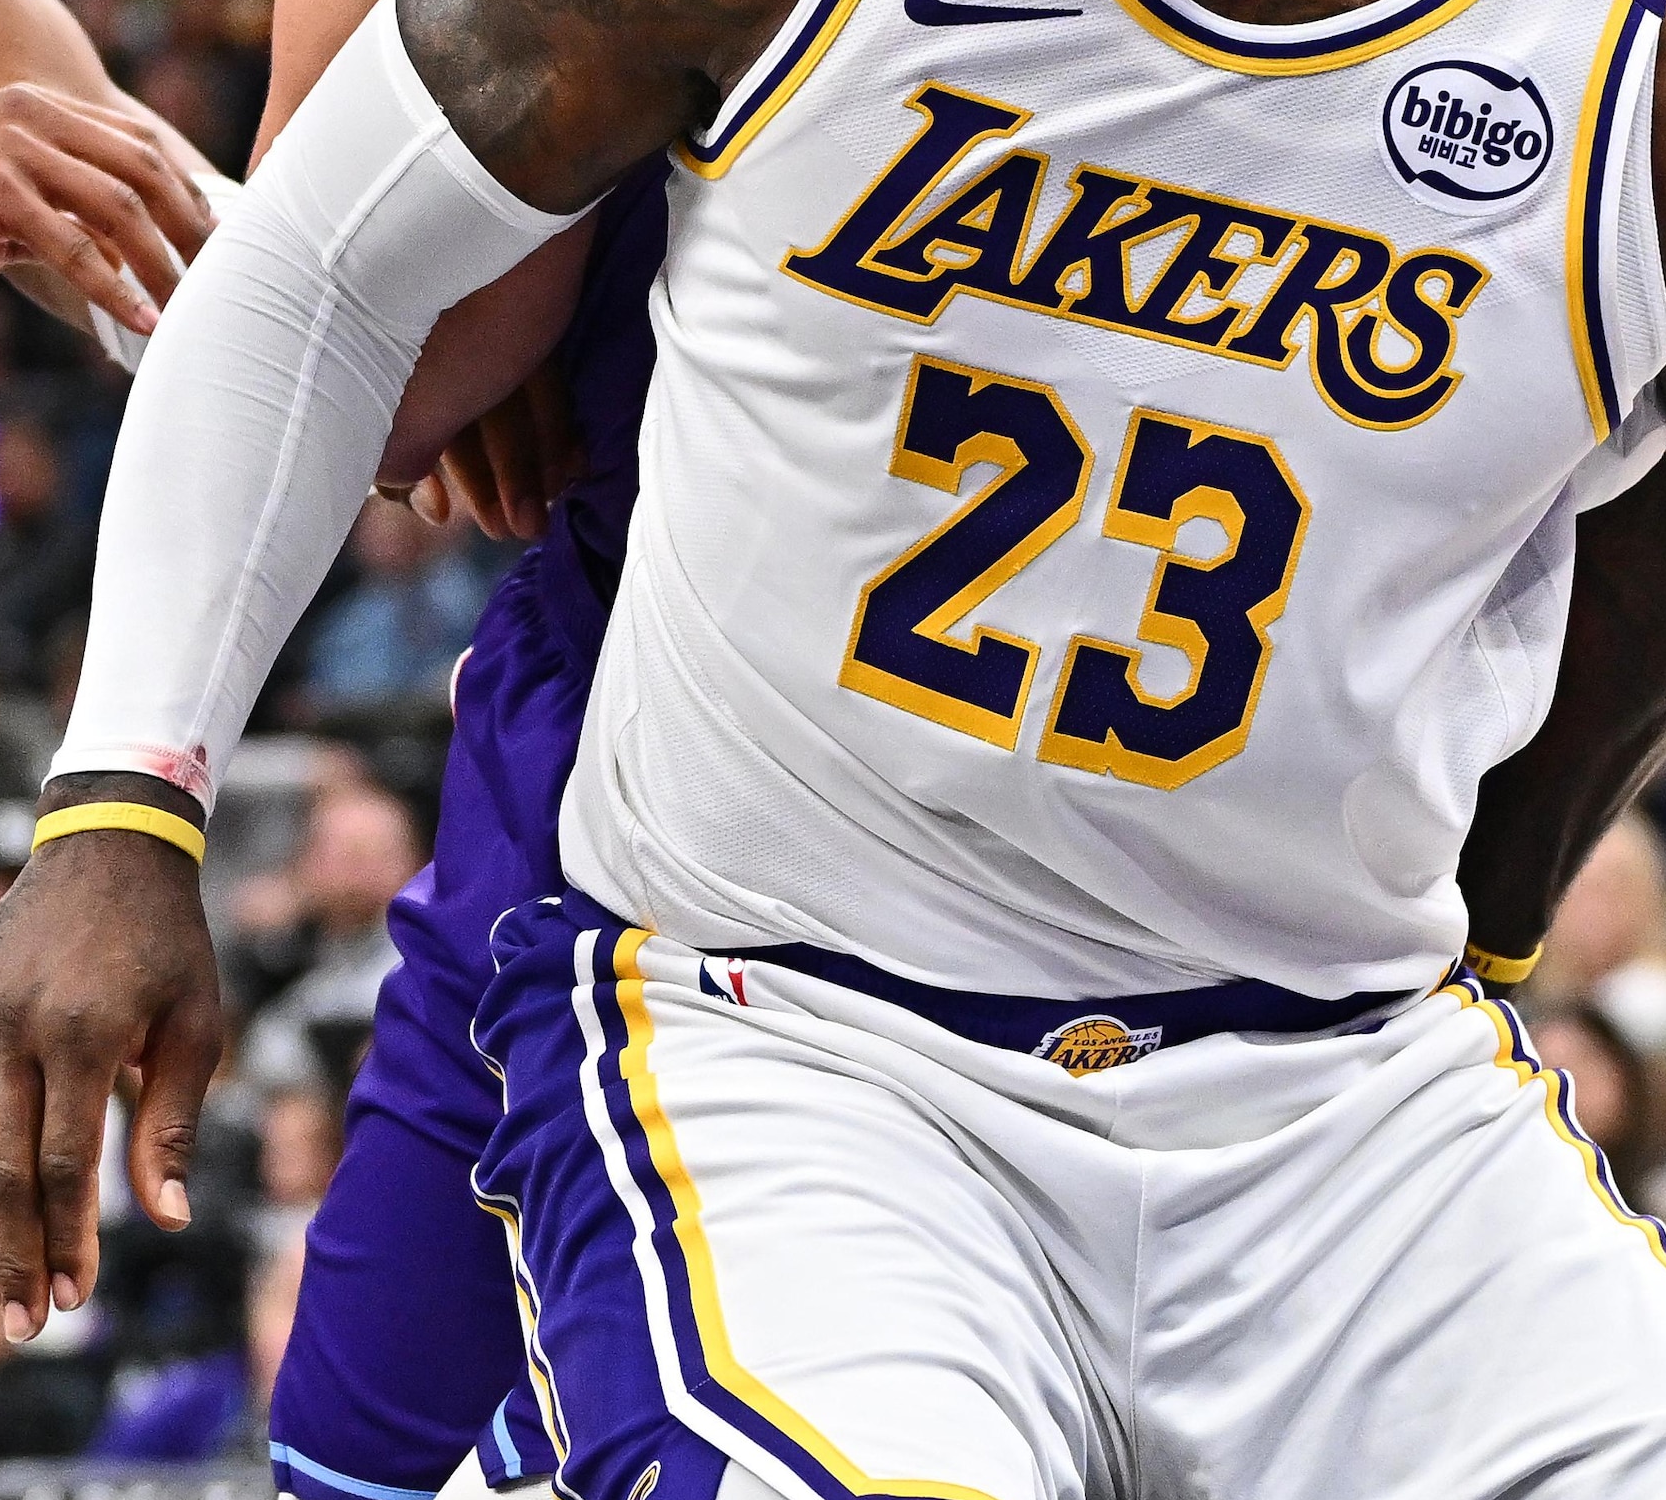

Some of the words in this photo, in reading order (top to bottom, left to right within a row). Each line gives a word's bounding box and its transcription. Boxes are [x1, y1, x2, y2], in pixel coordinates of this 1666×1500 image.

[1400, 85, 1543, 167] bibigo
[1418, 134, 1478, 170] 비비고
[778, 79, 1493, 433] LAKERS
[837, 352, 1313, 793] 23
[1072, 1038, 1098, 1047] LOS
[1099, 1031, 1159, 1046] ANGELES
